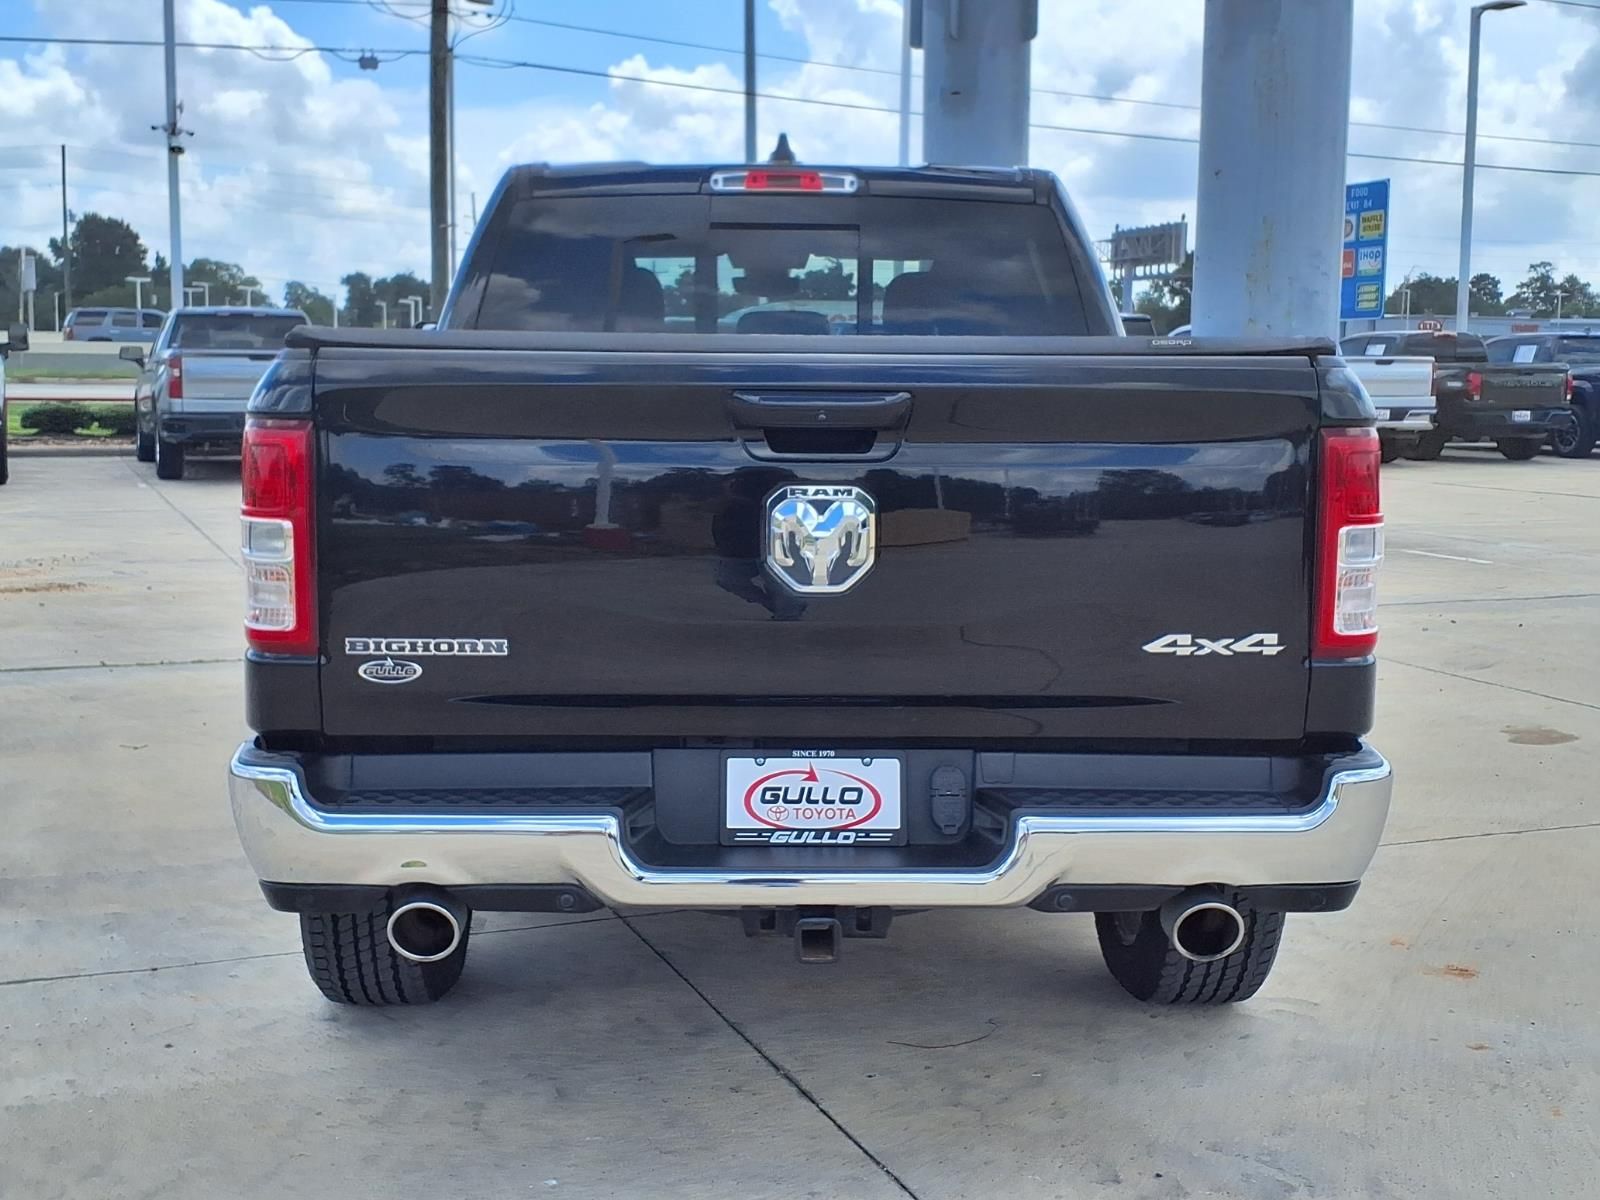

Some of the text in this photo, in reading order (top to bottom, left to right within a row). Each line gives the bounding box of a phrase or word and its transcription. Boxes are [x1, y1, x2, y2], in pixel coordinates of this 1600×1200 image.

[1351, 187, 1369, 198] FOOD
[788, 487, 854, 497] RAM
[345, 637, 508, 656] BIGHORN
[1141, 633, 1287, 656] 4x4
[364, 665, 418, 677] GULLO
[760, 786, 864, 805] GULLO
[792, 808, 856, 820] TOYOTA
[769, 831, 856, 844] GULLO
